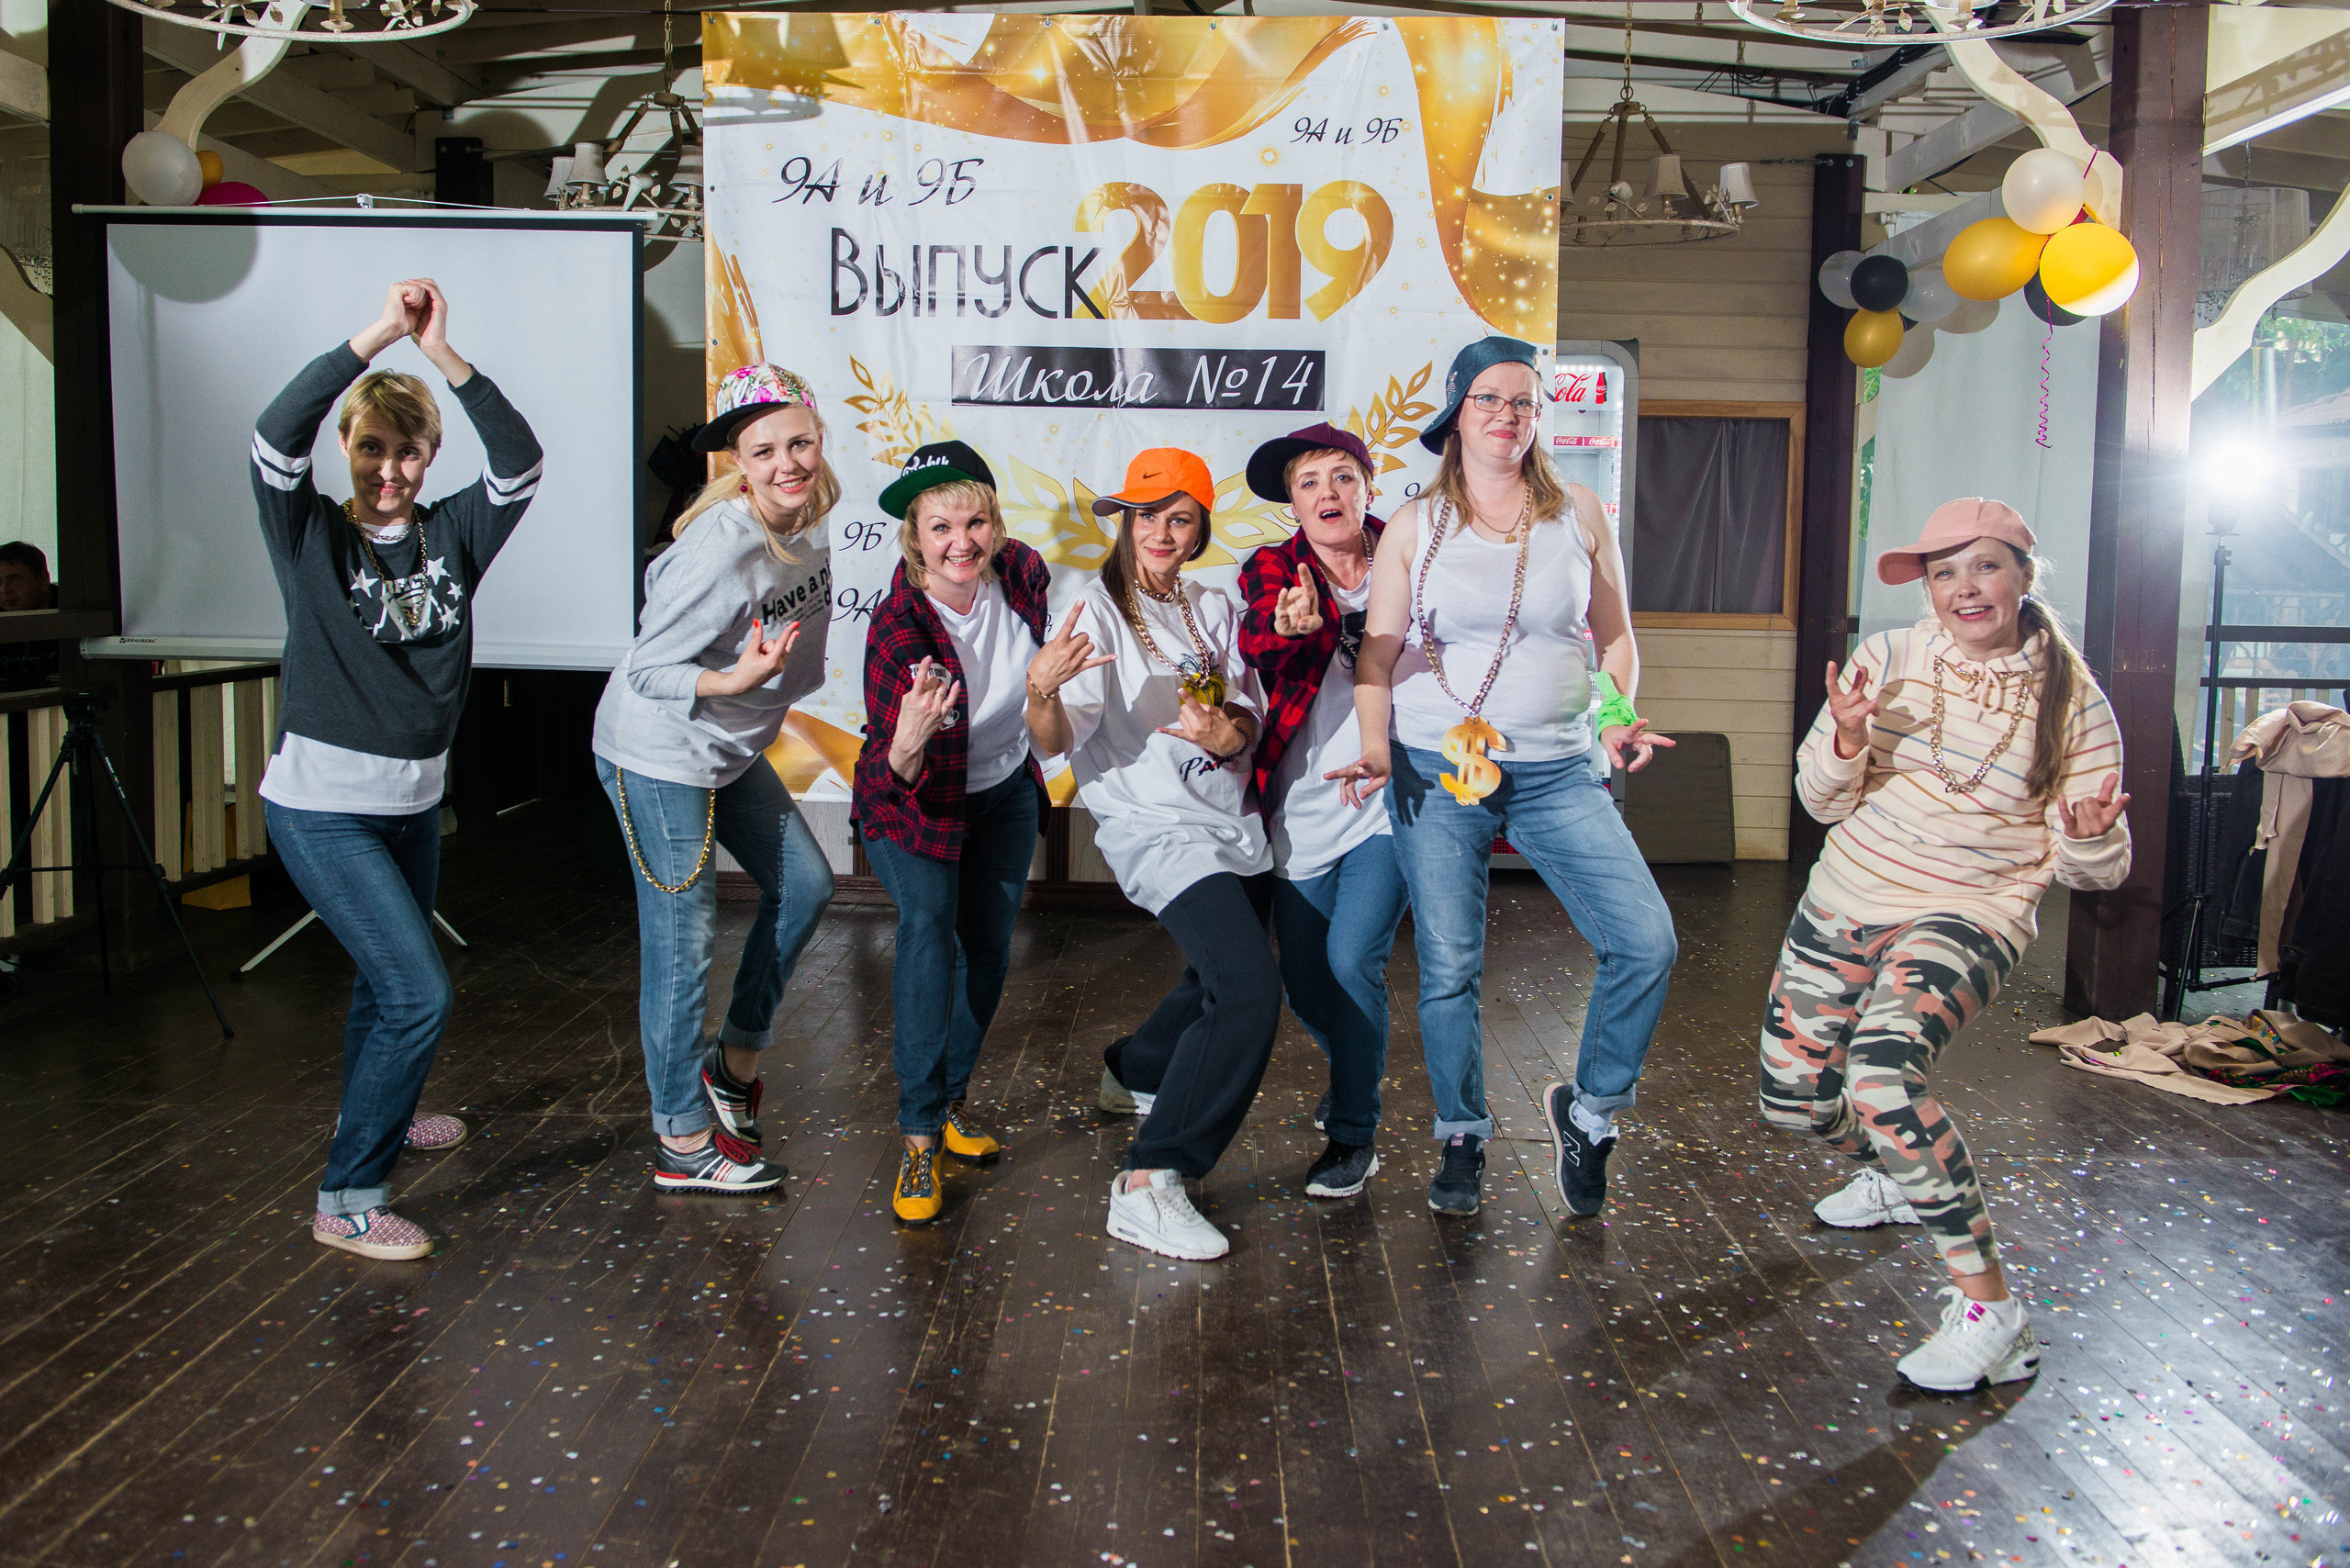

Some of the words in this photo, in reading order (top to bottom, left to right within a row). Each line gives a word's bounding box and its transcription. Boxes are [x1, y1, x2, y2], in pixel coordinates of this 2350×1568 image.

[1289, 117, 1328, 143] 9А
[1335, 127, 1354, 145] и
[1361, 118, 1404, 145] 9Б
[771, 156, 844, 205] 9А
[858, 174, 894, 206] и
[908, 157, 984, 206] 9Б
[1073, 179, 1394, 324] 2019
[964, 352, 1158, 405] Школа
[839, 521, 887, 552] 9Б
[761, 585, 807, 626] Have
[808, 576, 819, 594] a
